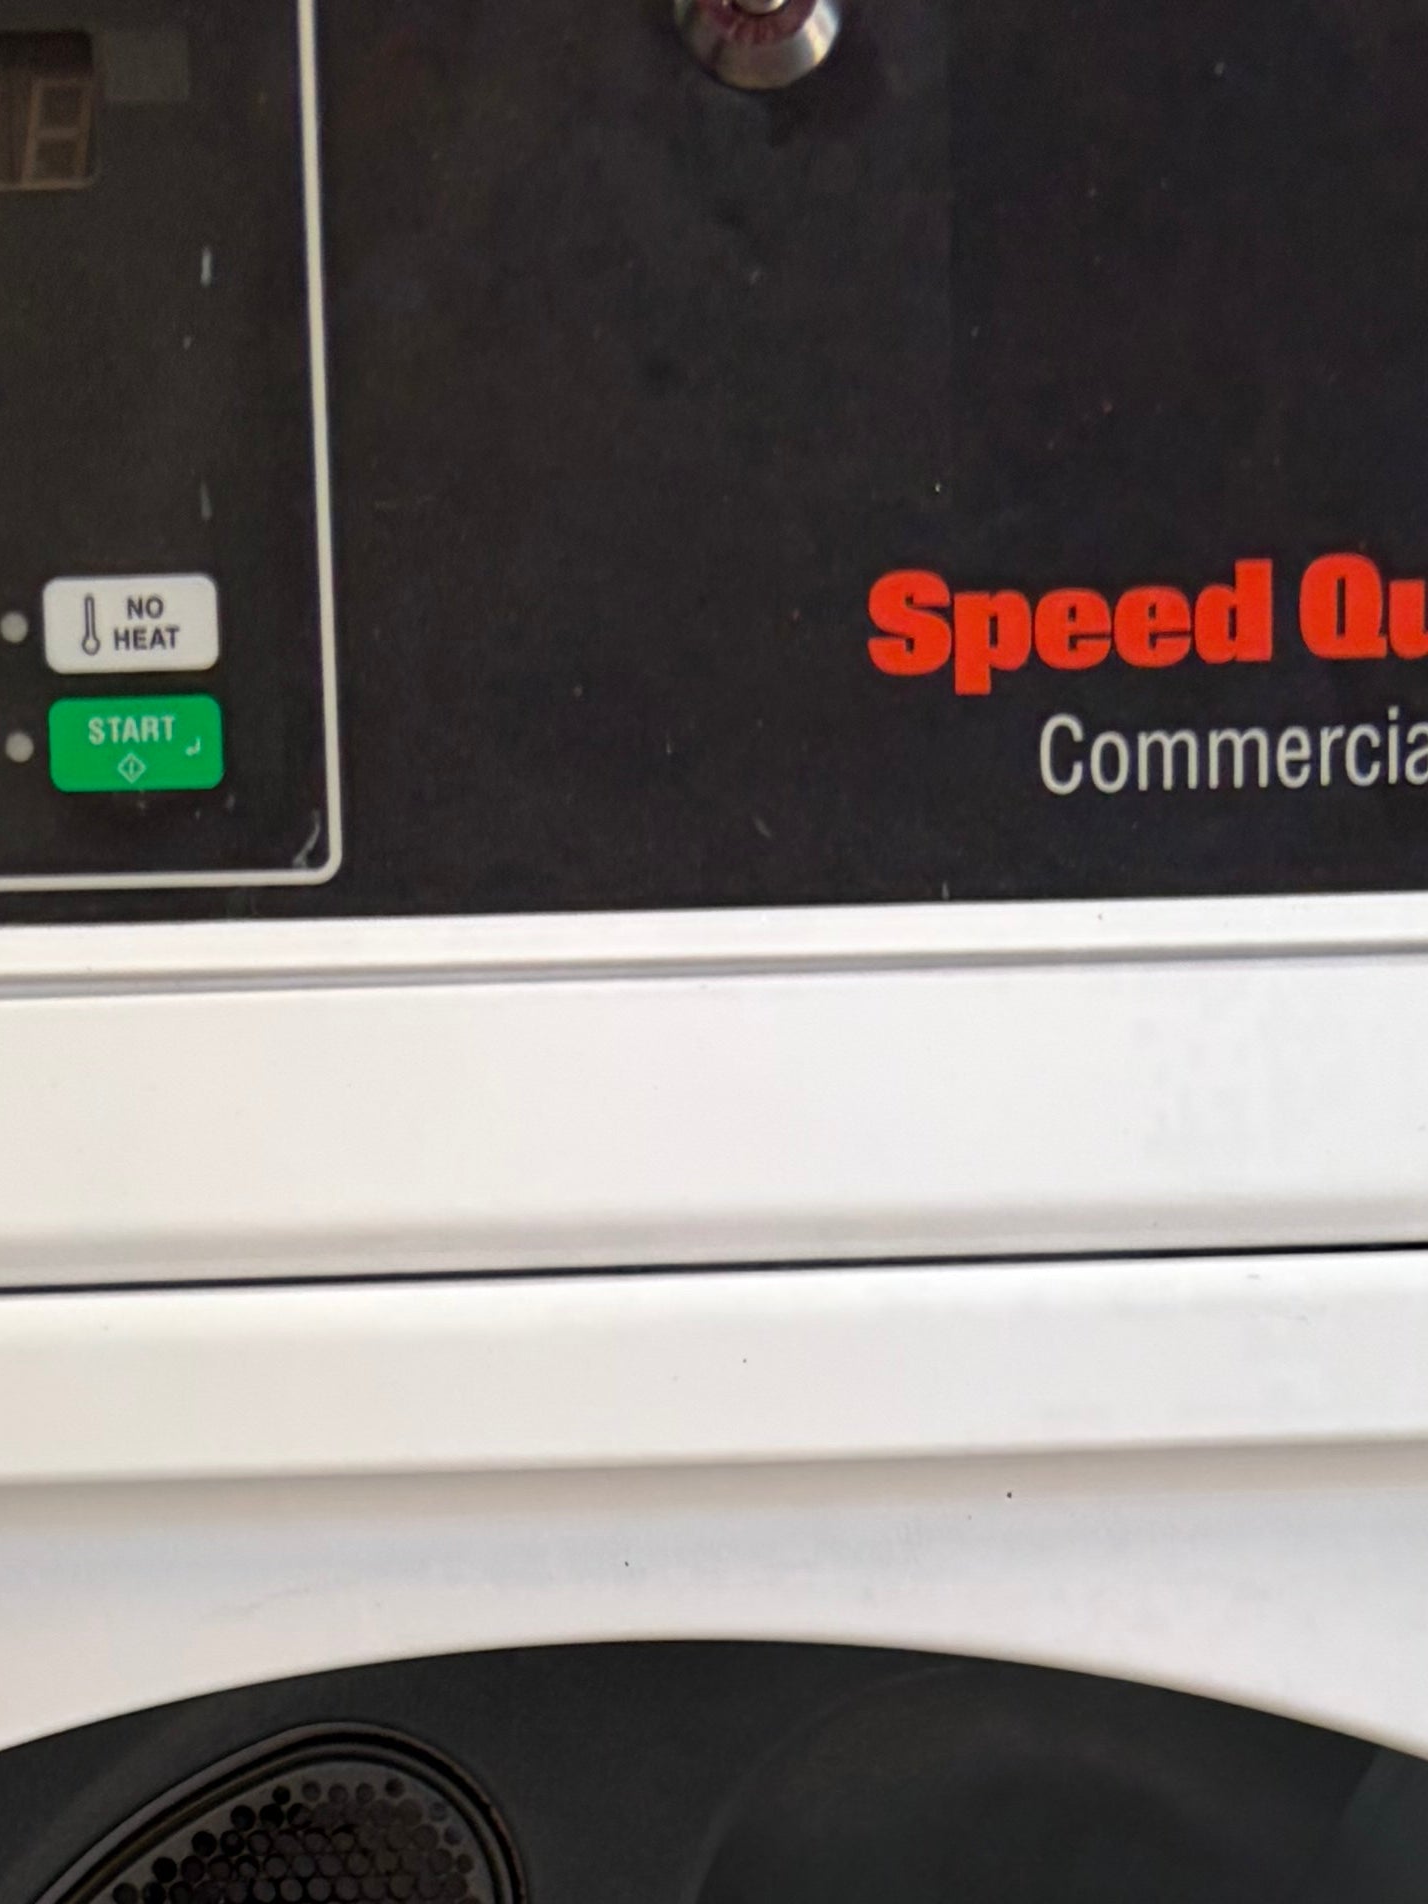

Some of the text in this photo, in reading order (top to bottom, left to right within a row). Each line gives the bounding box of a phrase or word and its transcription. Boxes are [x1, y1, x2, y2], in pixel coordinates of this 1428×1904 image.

[126, 597, 164, 620] NO
[113, 627, 181, 651] HEAT
[866, 559, 1273, 695] Speed
[88, 715, 176, 743] START
